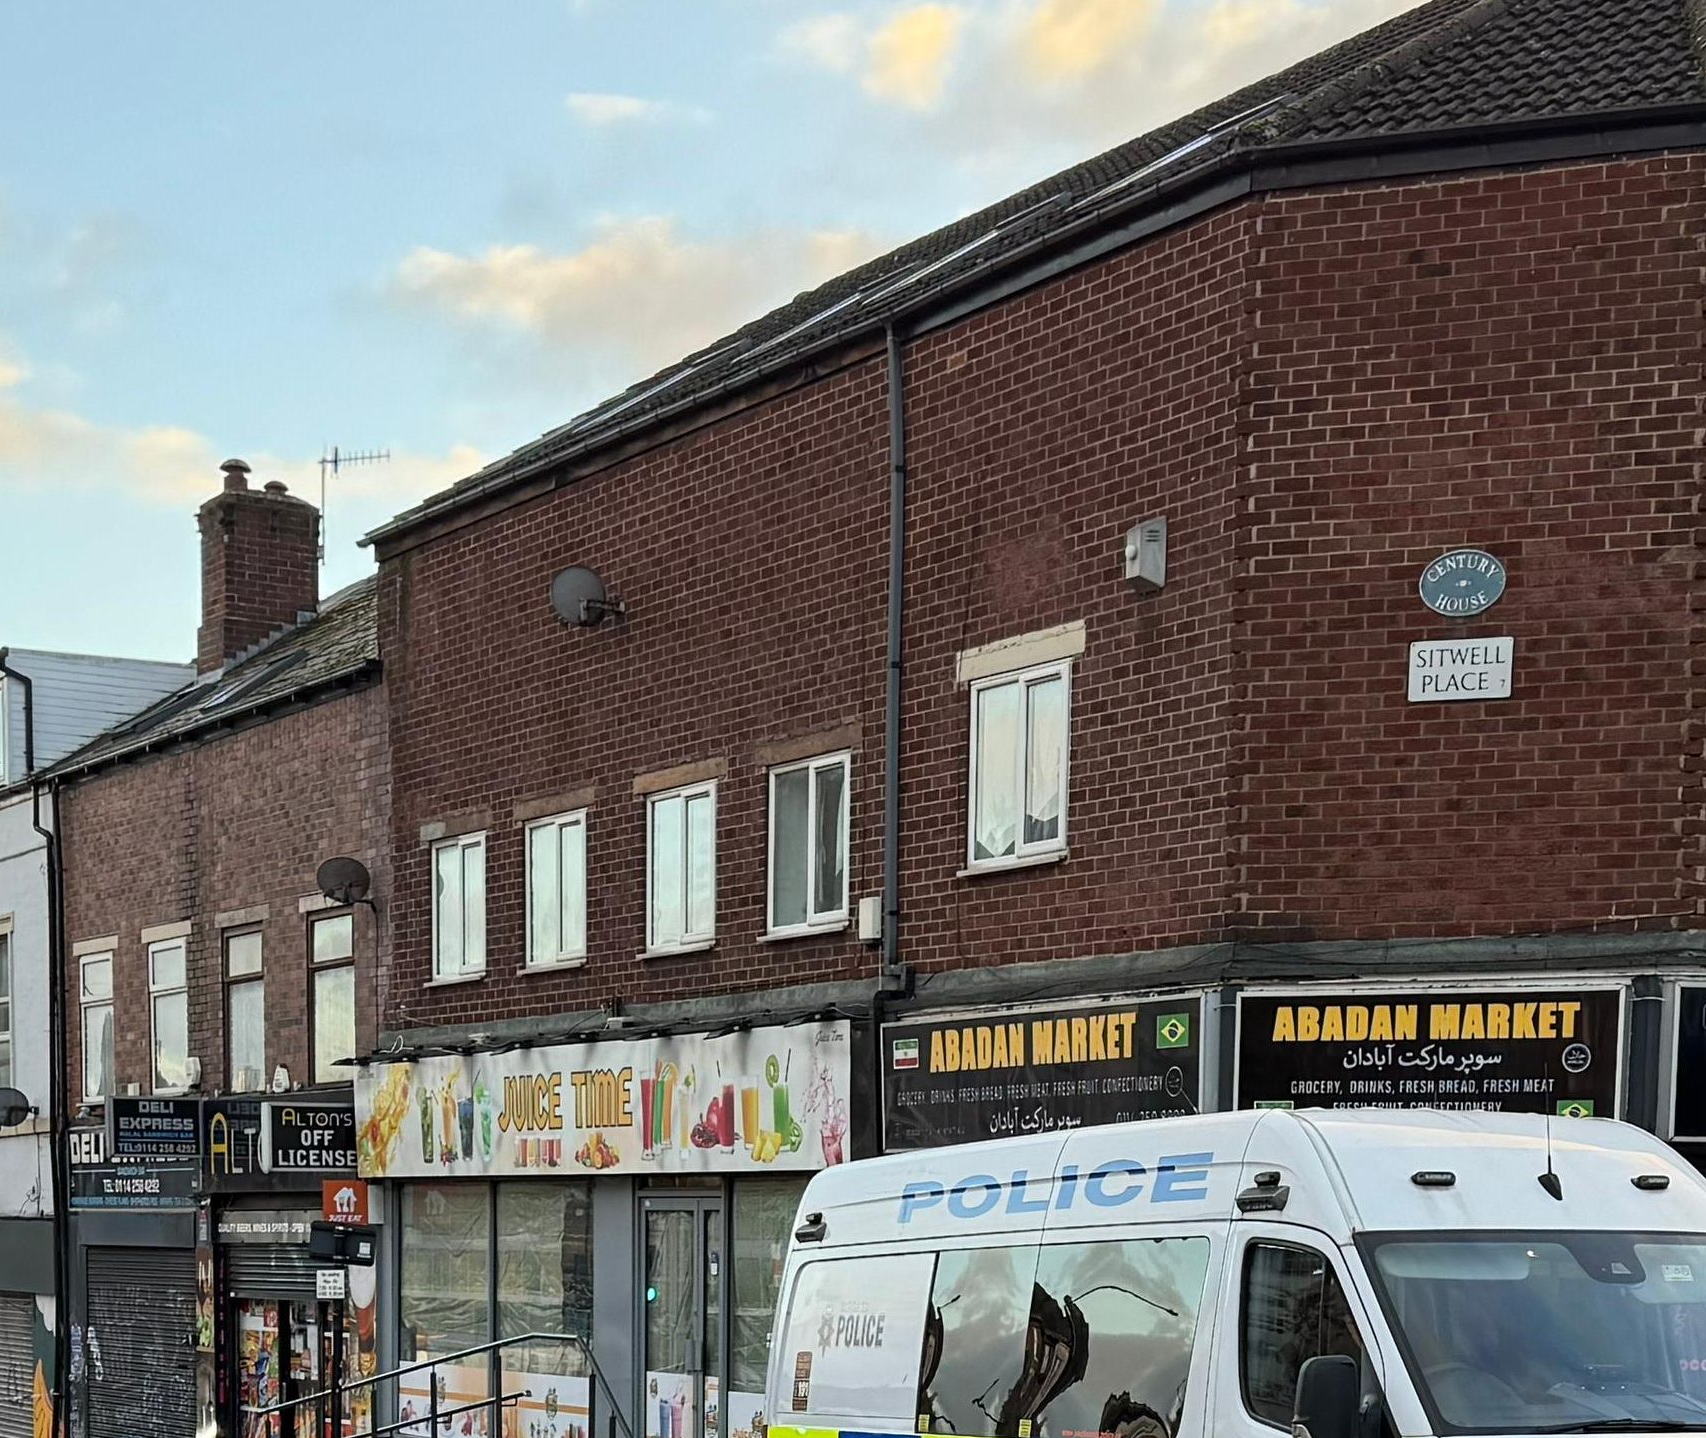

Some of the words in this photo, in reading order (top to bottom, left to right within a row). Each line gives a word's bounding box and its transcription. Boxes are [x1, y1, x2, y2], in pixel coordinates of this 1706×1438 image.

[1426, 553, 1501, 583] CENTURY
[1434, 590, 1489, 611] HOUSE
[1416, 645, 1506, 668] SITWELL
[1421, 671, 1490, 694] PLACE
[1499, 678, 1506, 688] 7
[1272, 1004, 1418, 1042] ABADAN
[1428, 1001, 1582, 1041] MARKET
[928, 1022, 1025, 1073] ABADAN
[1031, 1011, 1137, 1066] MARKET
[1342, 1044, 1395, 1069] آبادان
[1397, 1043, 1457, 1068] مارکت
[1459, 1052, 1503, 1074] سوپر
[497, 1072, 564, 1133] JUICE
[569, 1065, 634, 1129] TIME
[1290, 1080, 1344, 1096] GROCERY,
[1349, 1080, 1395, 1096] DRINKS,
[1398, 1080, 1435, 1094] FRESH
[1438, 1080, 1480, 1095] BREAD,
[1483, 1079, 1520, 1093] FRESH
[1523, 1079, 1555, 1092] MEAT
[138, 1100, 174, 1114] DELI
[119, 1117, 194, 1131] EXPRESS
[69, 1132, 105, 1165] DELI
[210, 1112, 265, 1175] ALT
[300, 1129, 335, 1147] OFF
[277, 1149, 358, 1167] LICENSE
[896, 1151, 1215, 1224] POLICE
[328, 1214, 346, 1222] JUST
[347, 1214, 363, 1222] EAT
[834, 1312, 886, 1348] POLICE
